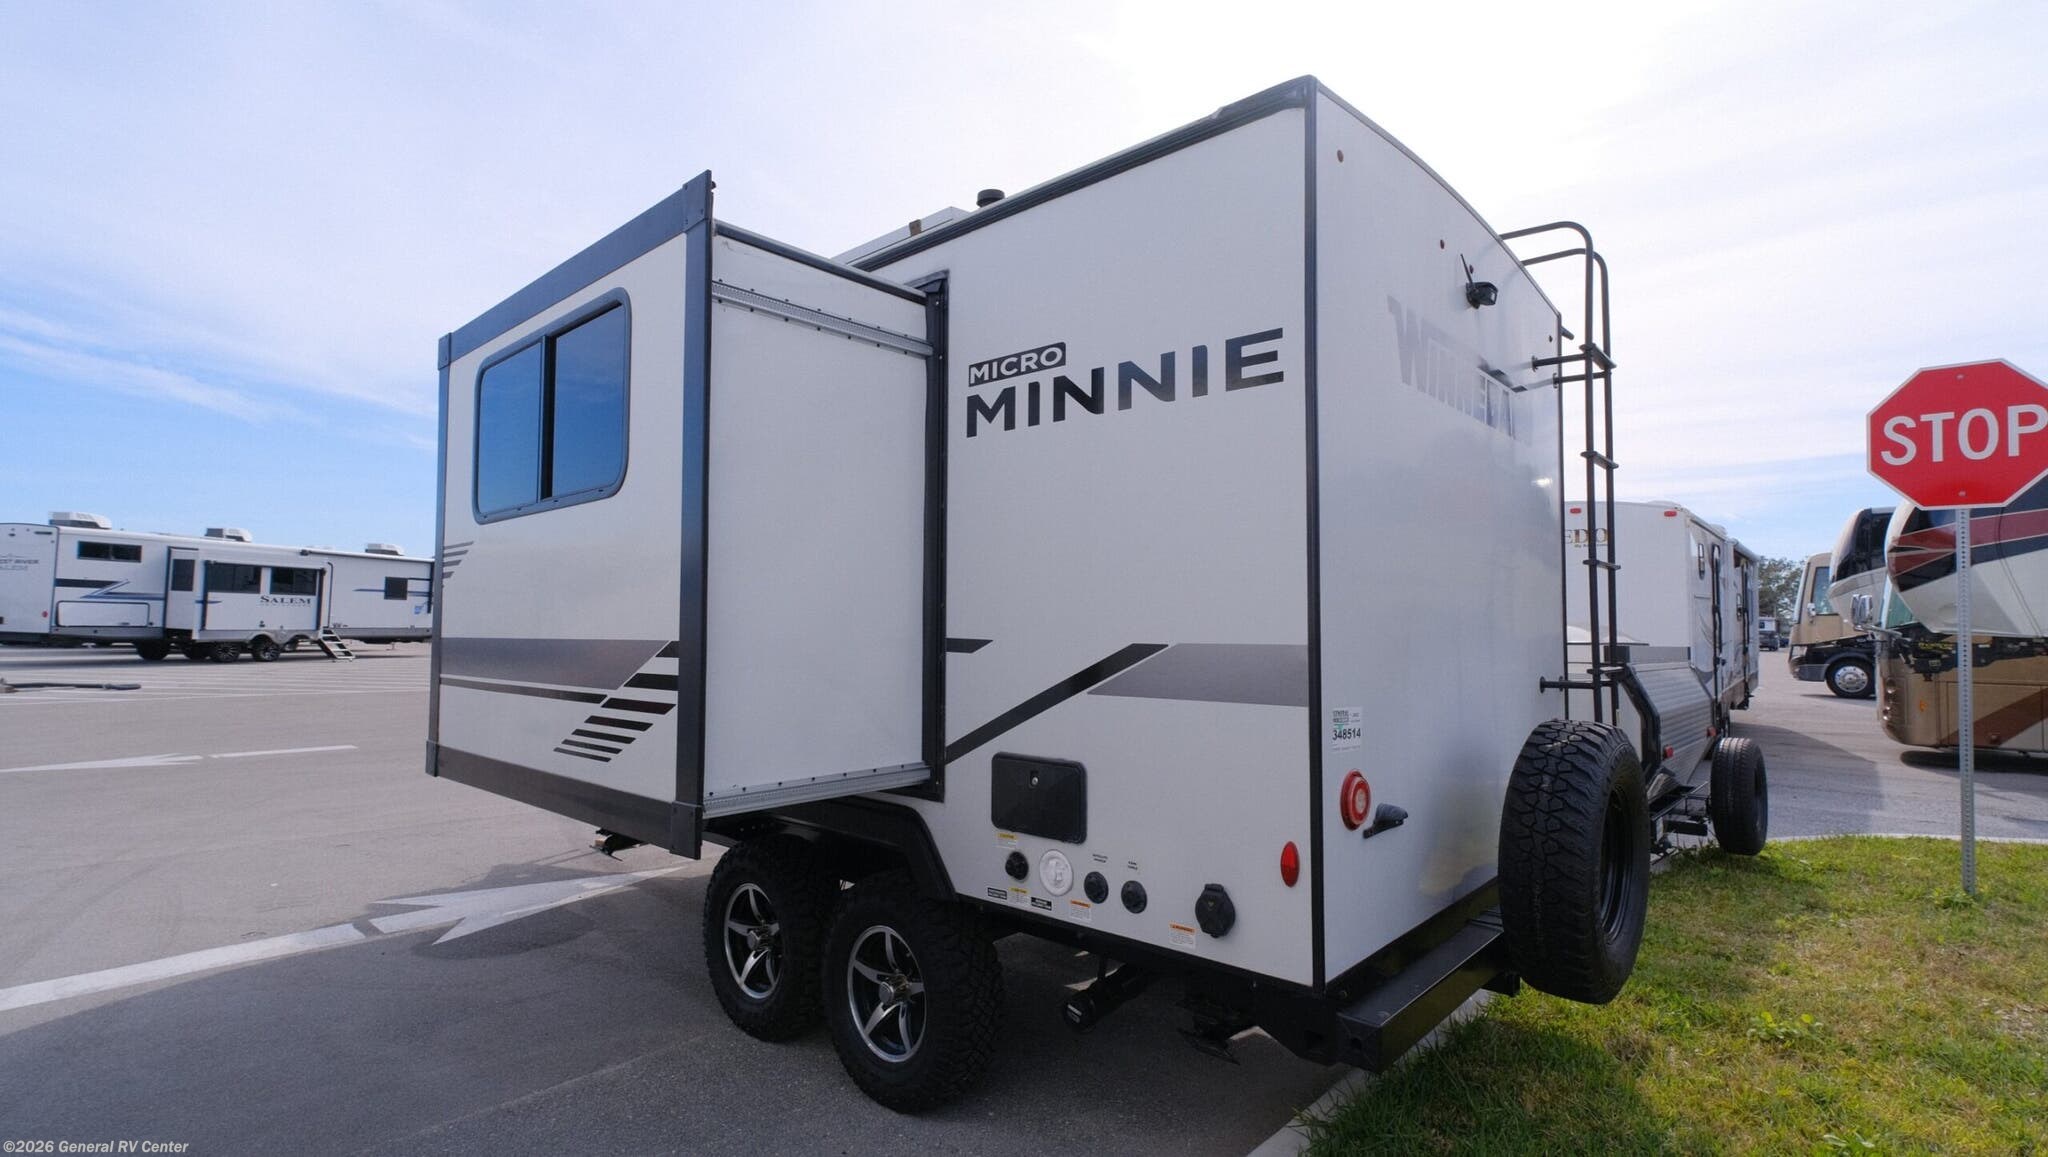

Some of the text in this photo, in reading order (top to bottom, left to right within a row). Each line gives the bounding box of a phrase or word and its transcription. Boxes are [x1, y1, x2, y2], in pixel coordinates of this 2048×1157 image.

[966, 327, 1284, 438] MINNIE
[969, 346, 1063, 385] MICRO
[1880, 403, 2048, 466] STOP
[260, 595, 311, 604] SALEM
[1332, 727, 1362, 741] 348514
